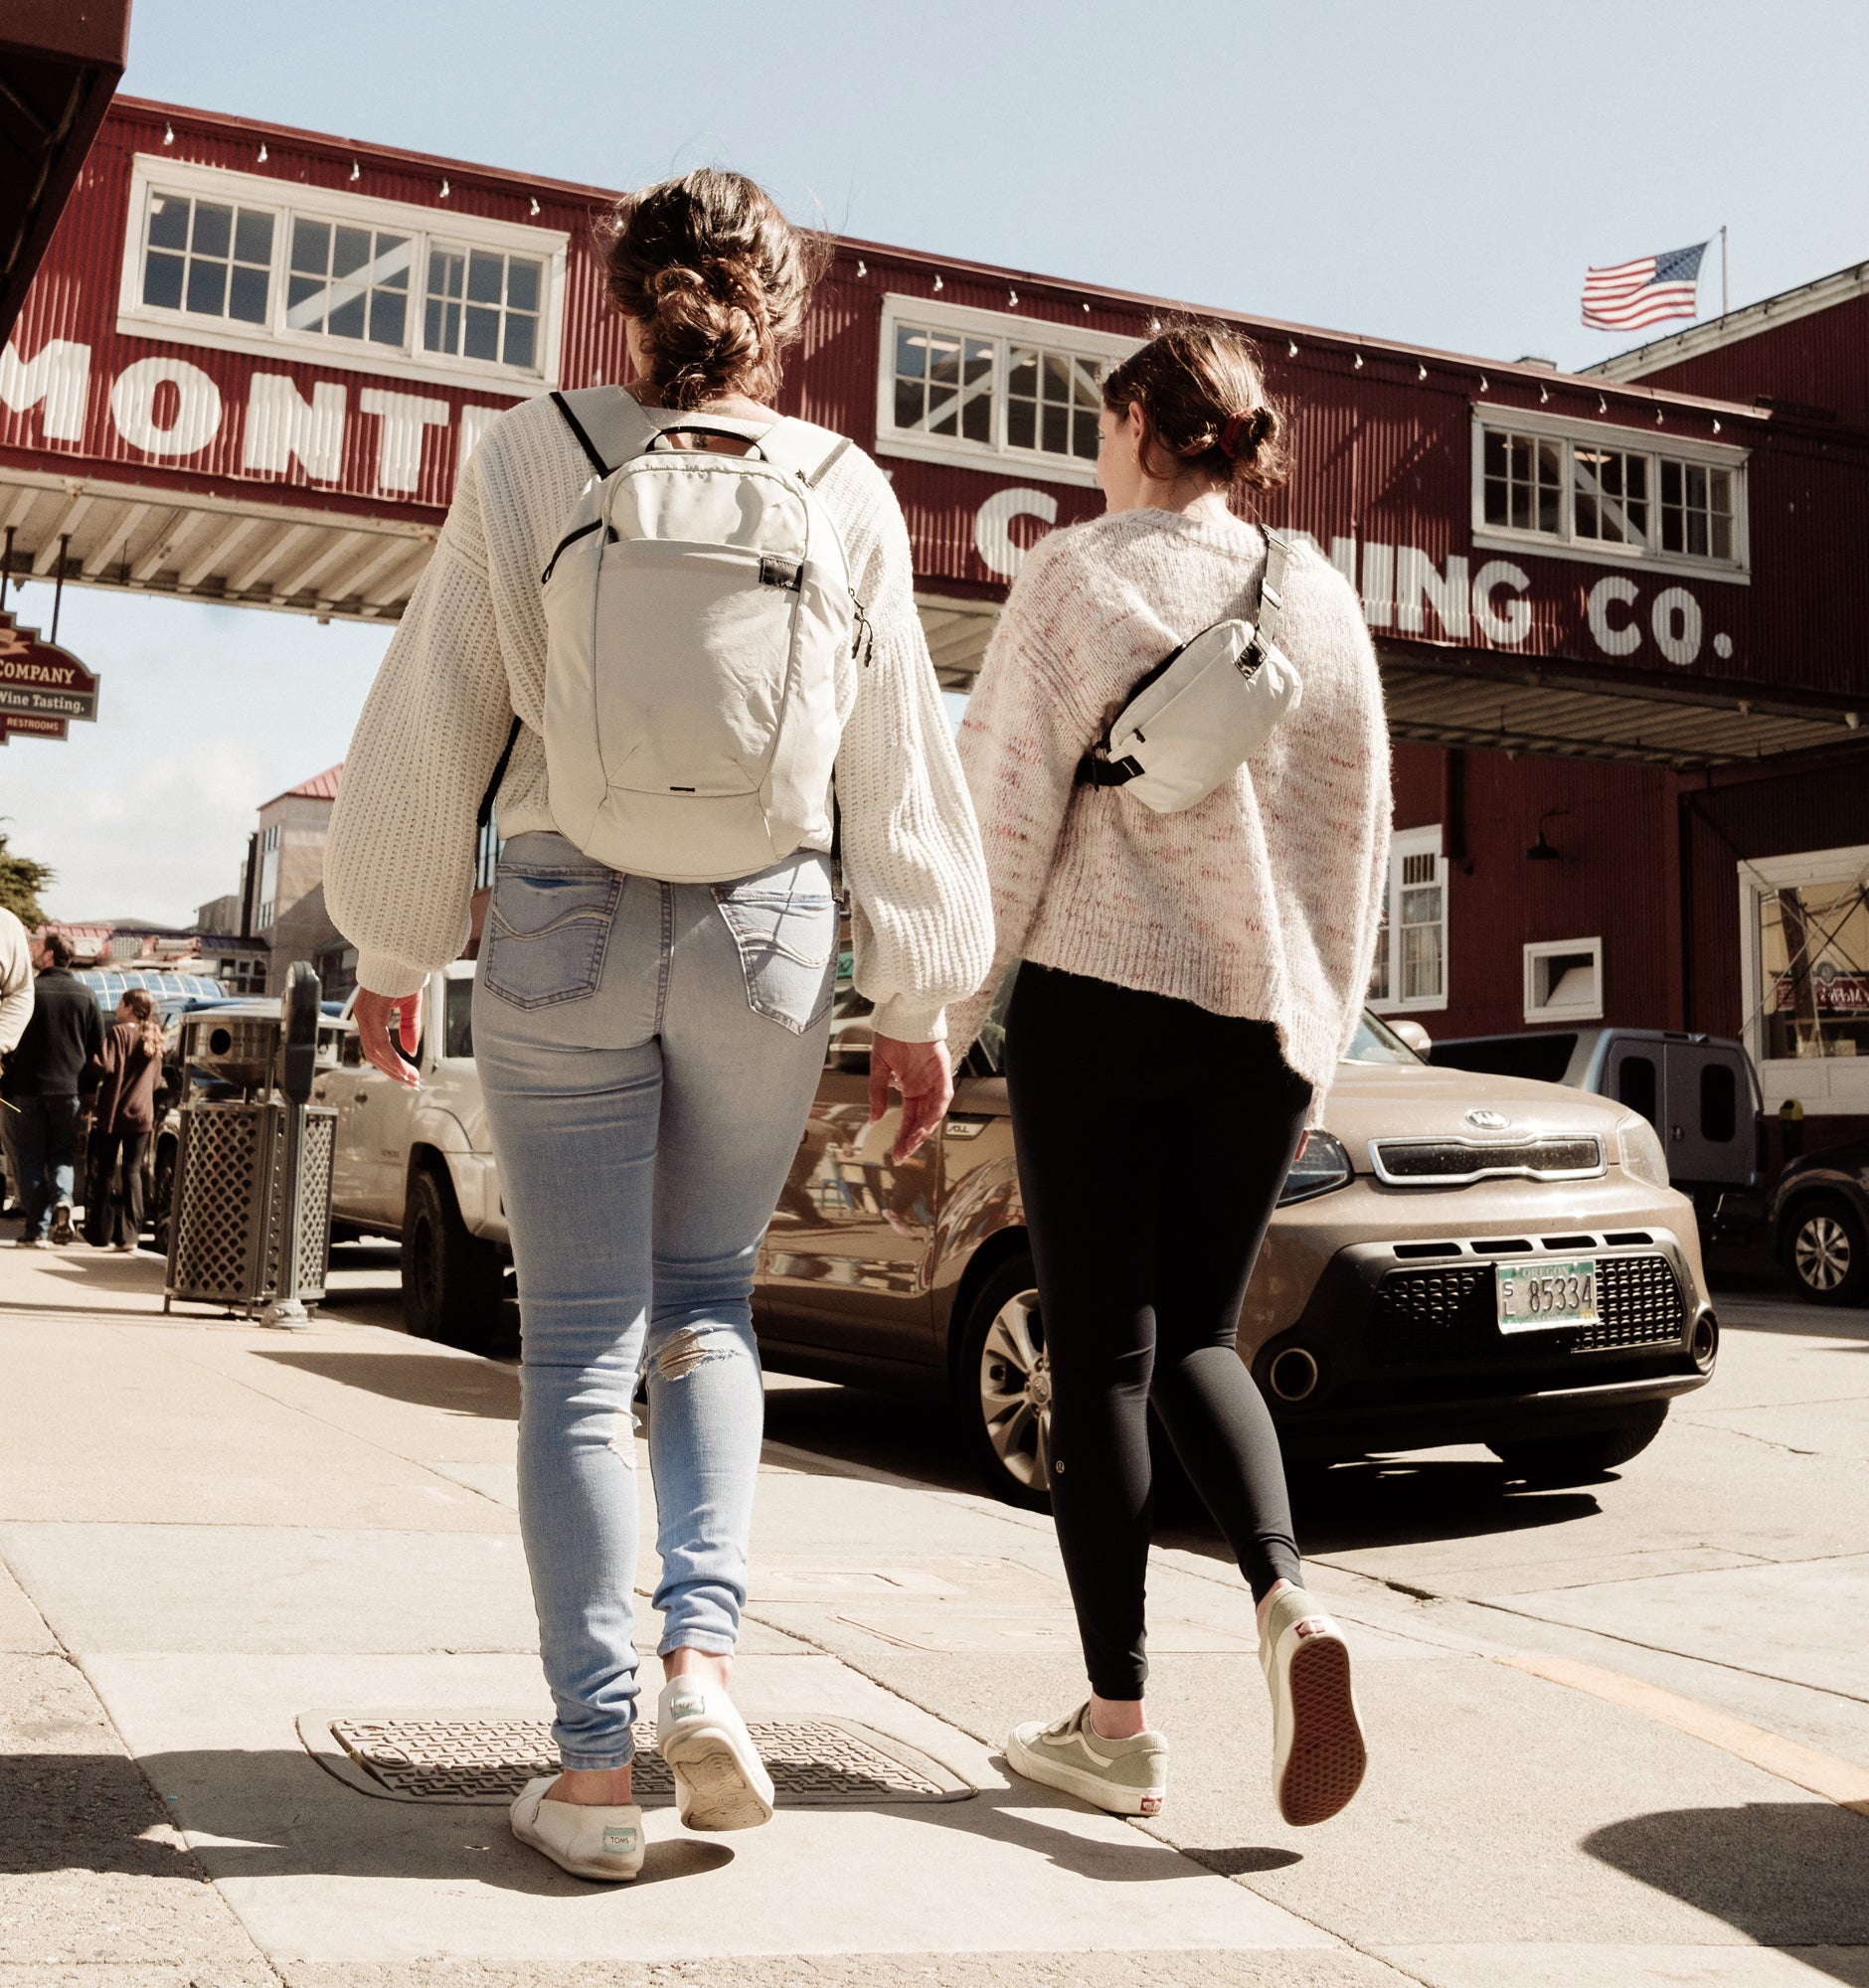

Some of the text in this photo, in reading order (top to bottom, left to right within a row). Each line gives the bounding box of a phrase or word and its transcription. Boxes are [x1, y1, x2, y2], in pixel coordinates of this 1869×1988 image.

[1588, 576, 1733, 666] CO.
[7, 718, 60, 732] RESTROOMS
[1523, 1265, 1570, 1278] OREGON
[1529, 1273, 1593, 1313] 85334
